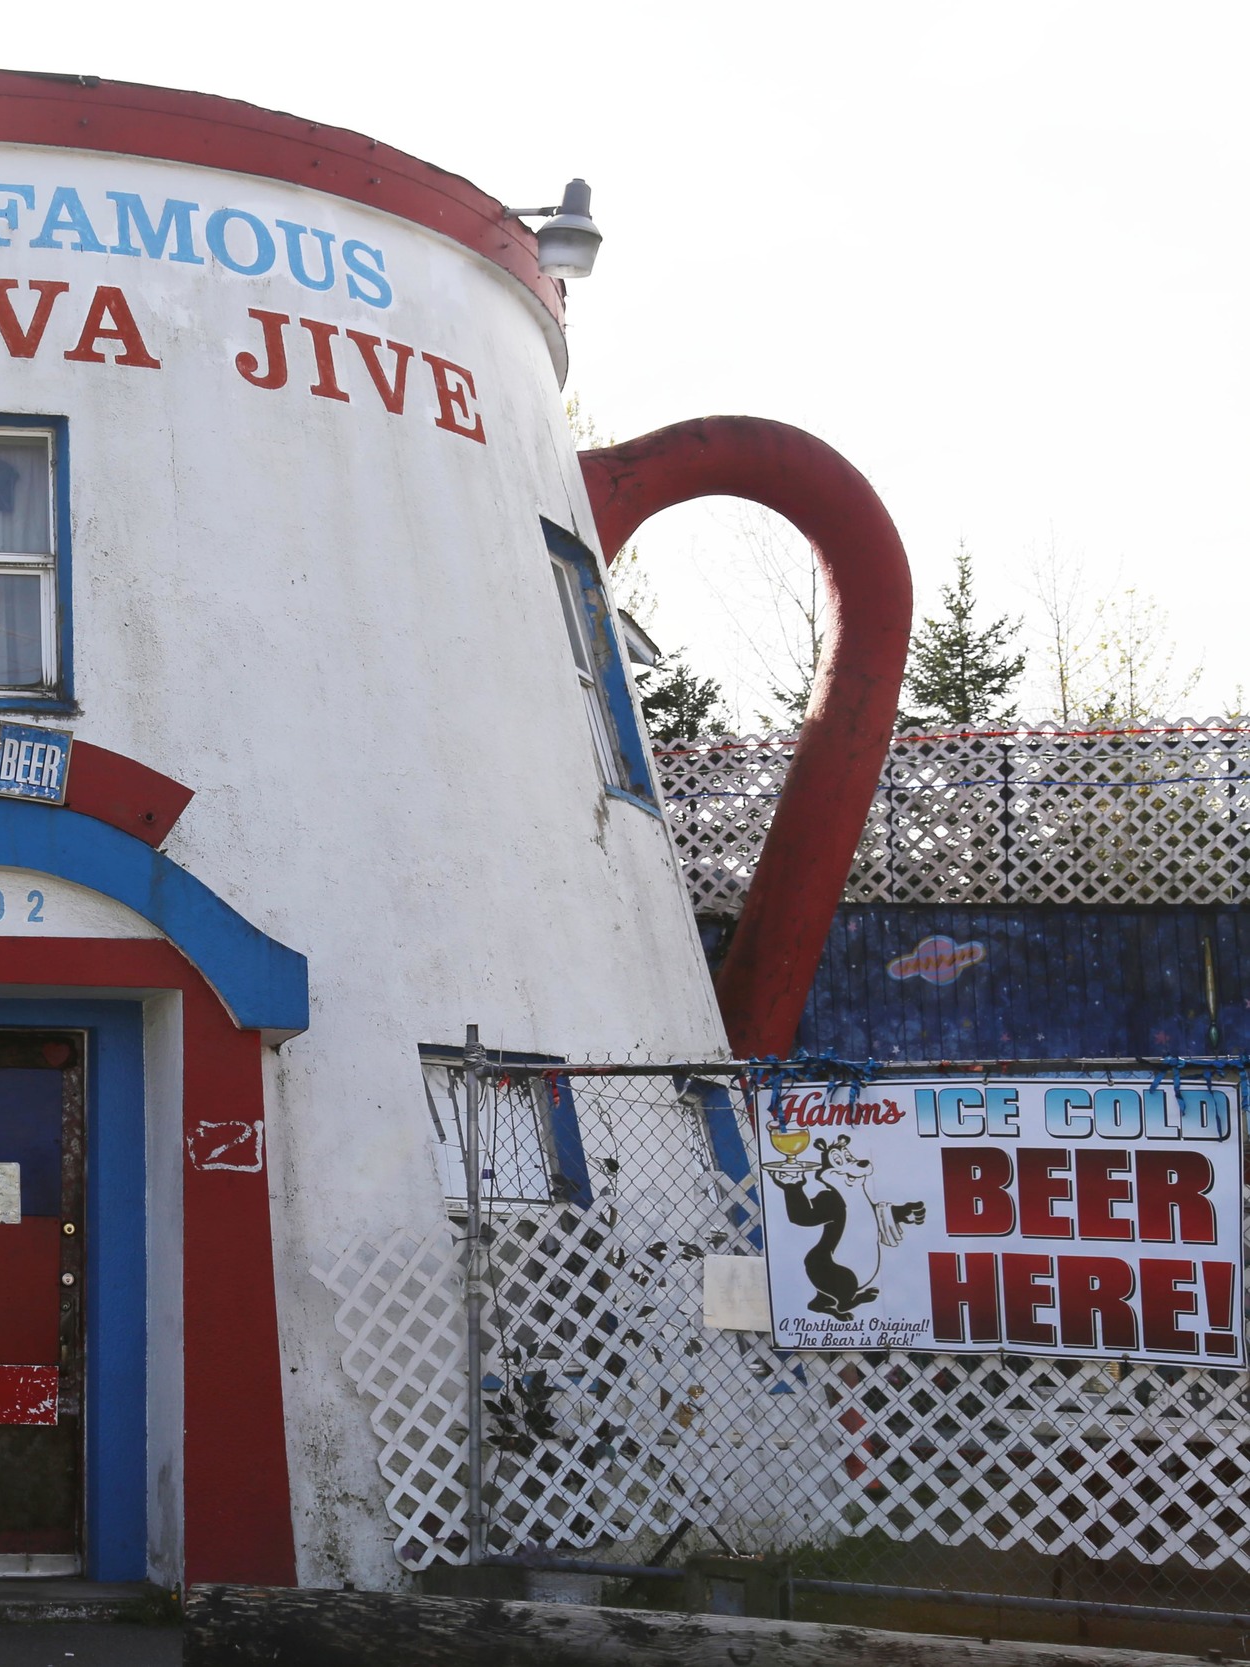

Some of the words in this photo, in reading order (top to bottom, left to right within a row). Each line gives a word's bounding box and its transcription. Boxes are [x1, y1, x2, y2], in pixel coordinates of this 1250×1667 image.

[235, 308, 486, 445] JIVE
[0, 738, 61, 788] BEER
[771, 1091, 906, 1127] Hamm's
[914, 1087, 1020, 1138] ICE
[1044, 1088, 1231, 1141] COLD
[940, 1146, 1218, 1245] BEER
[779, 1317, 789, 1331] A
[793, 1317, 865, 1332] Northwest
[868, 1317, 930, 1335] Original!
[927, 1251, 1238, 1358] HERE!
[821, 1332, 855, 1347] Bear
[859, 1333, 872, 1346] is
